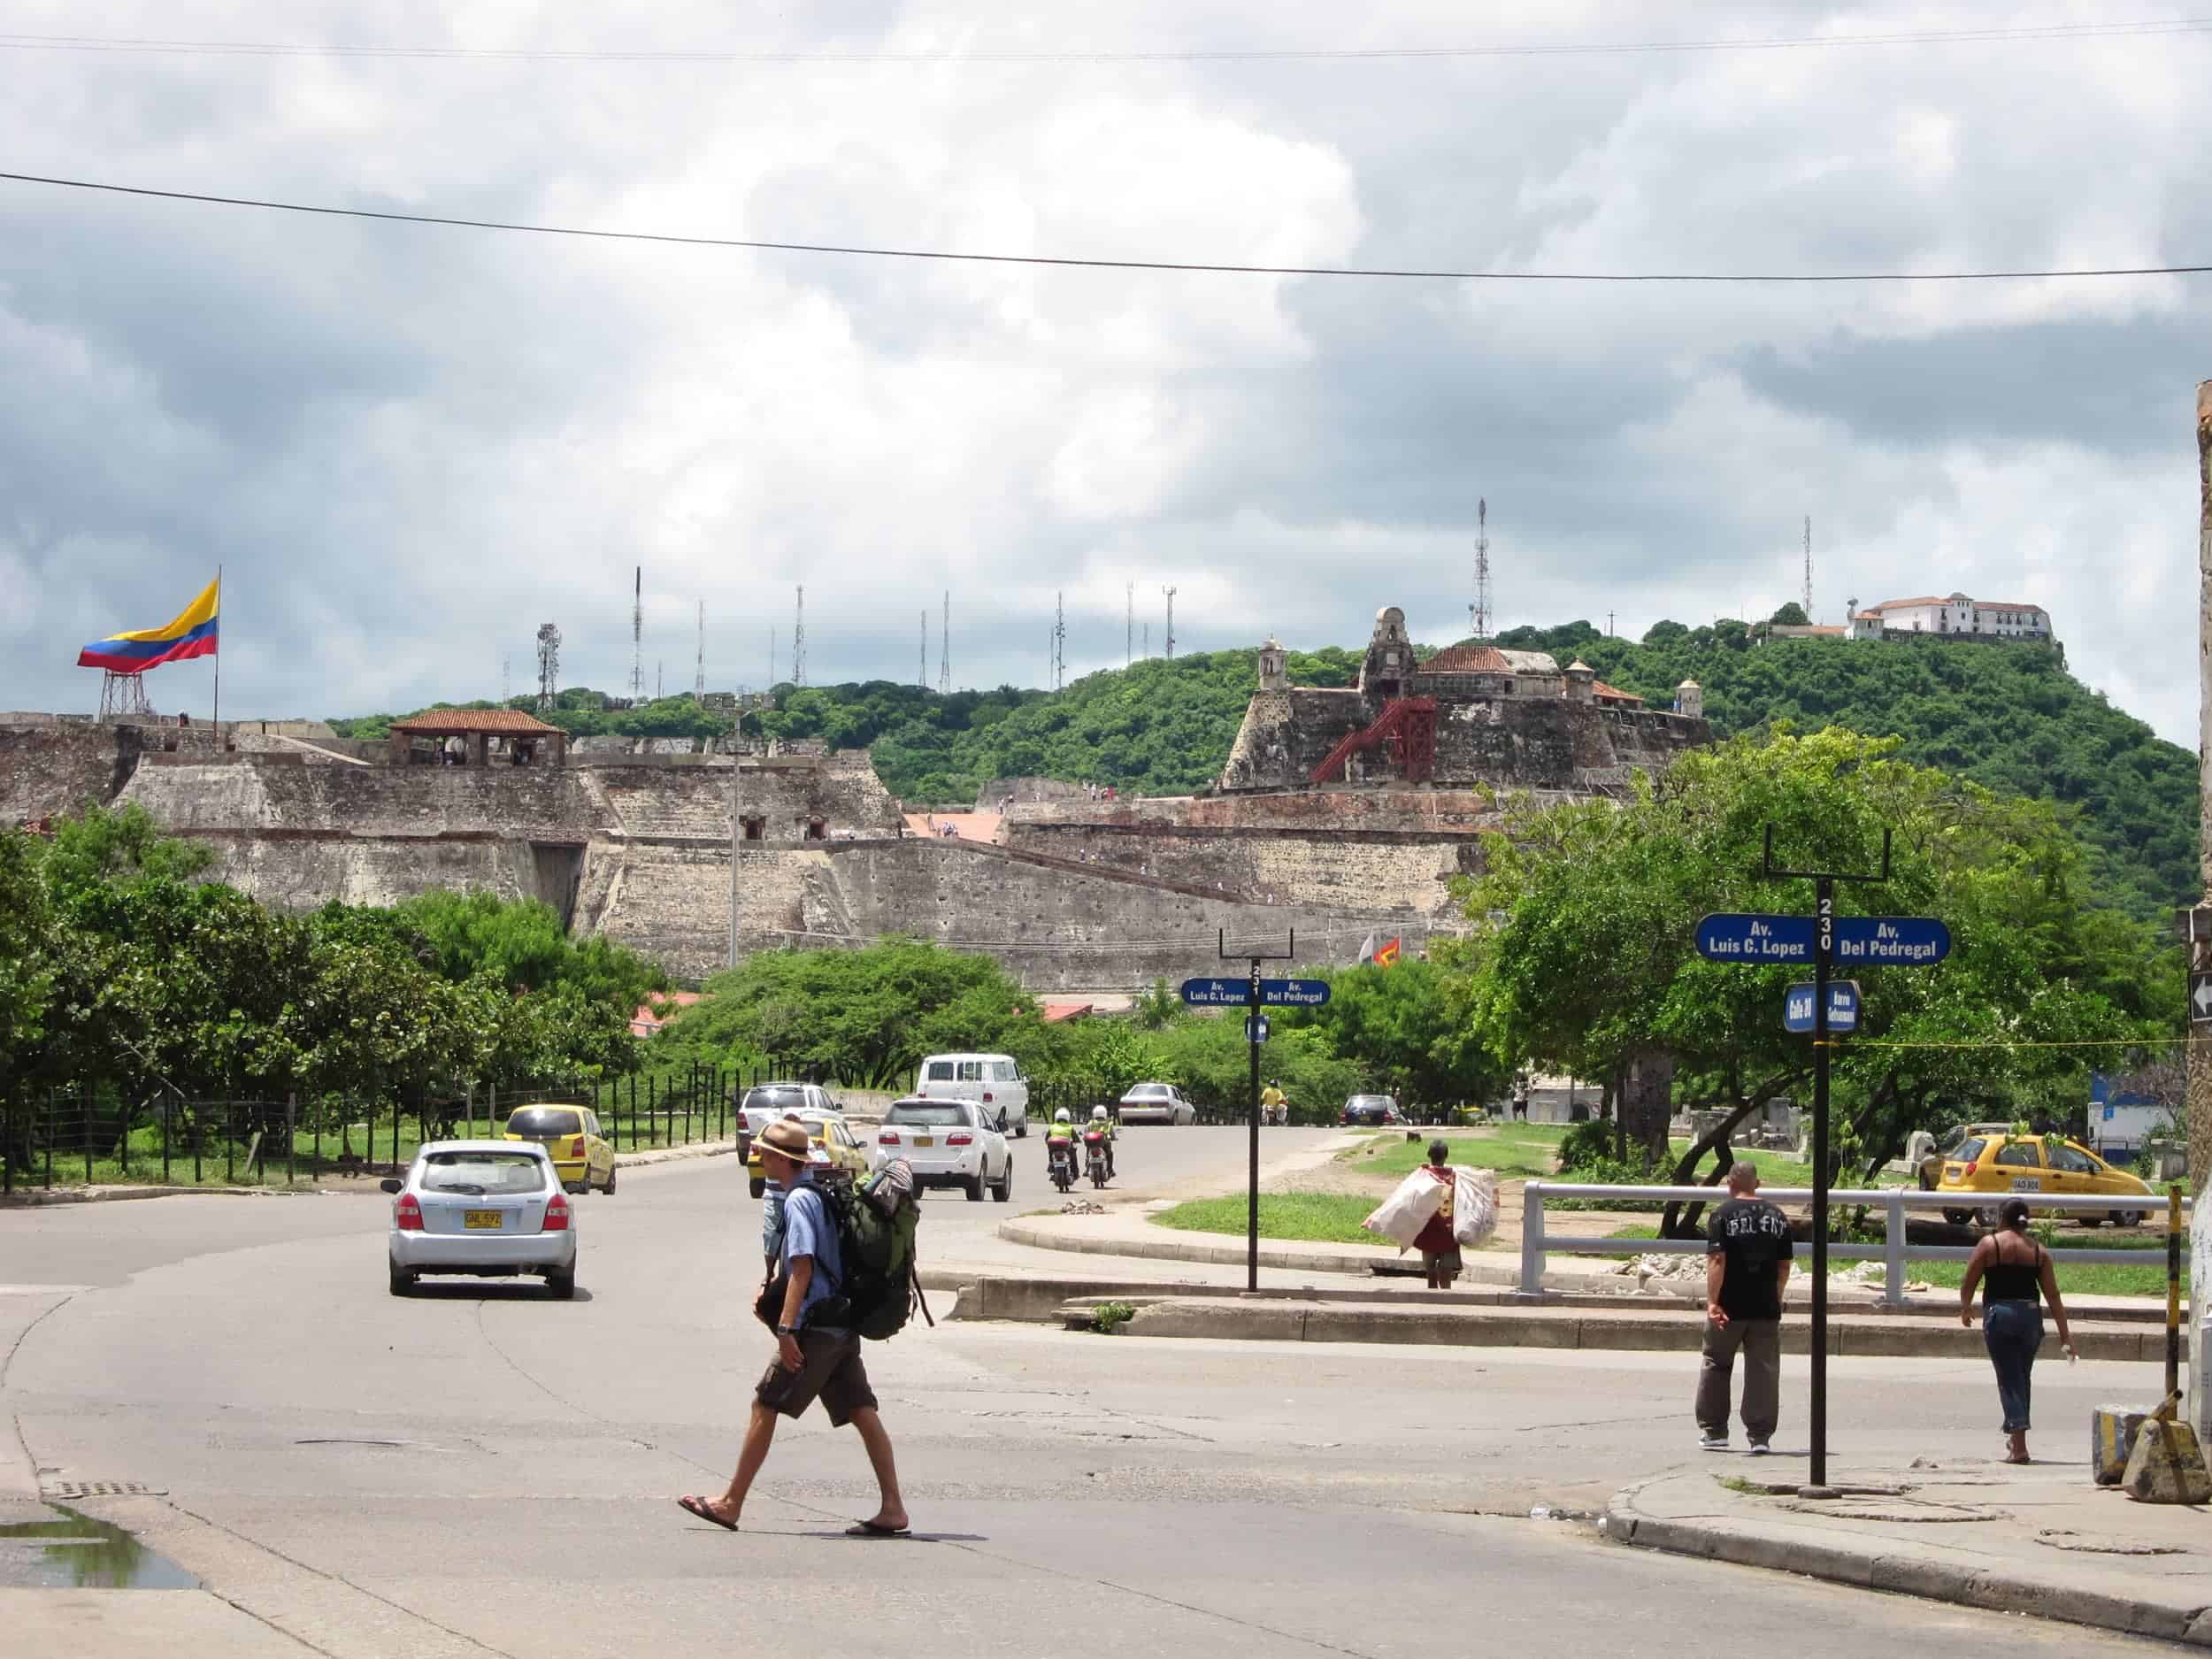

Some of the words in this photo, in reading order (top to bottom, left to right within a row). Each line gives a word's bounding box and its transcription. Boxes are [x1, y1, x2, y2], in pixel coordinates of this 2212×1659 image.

[1750, 921, 1772, 936] Av.
[1877, 923, 1900, 938] Av.
[1709, 936, 1740, 953] Luis
[1763, 939, 1805, 957] Lopez
[1840, 940, 1864, 956] Del
[1870, 941, 1936, 959] Pedregal
[1210, 981, 1225, 991] Av.
[1288, 982, 1302, 992] Av.
[1190, 991, 1208, 1001] Luis
[1220, 992, 1246, 1002] Lopez
[1267, 992, 1281, 1001] Del
[1284, 992, 1323, 1002] Pedregal
